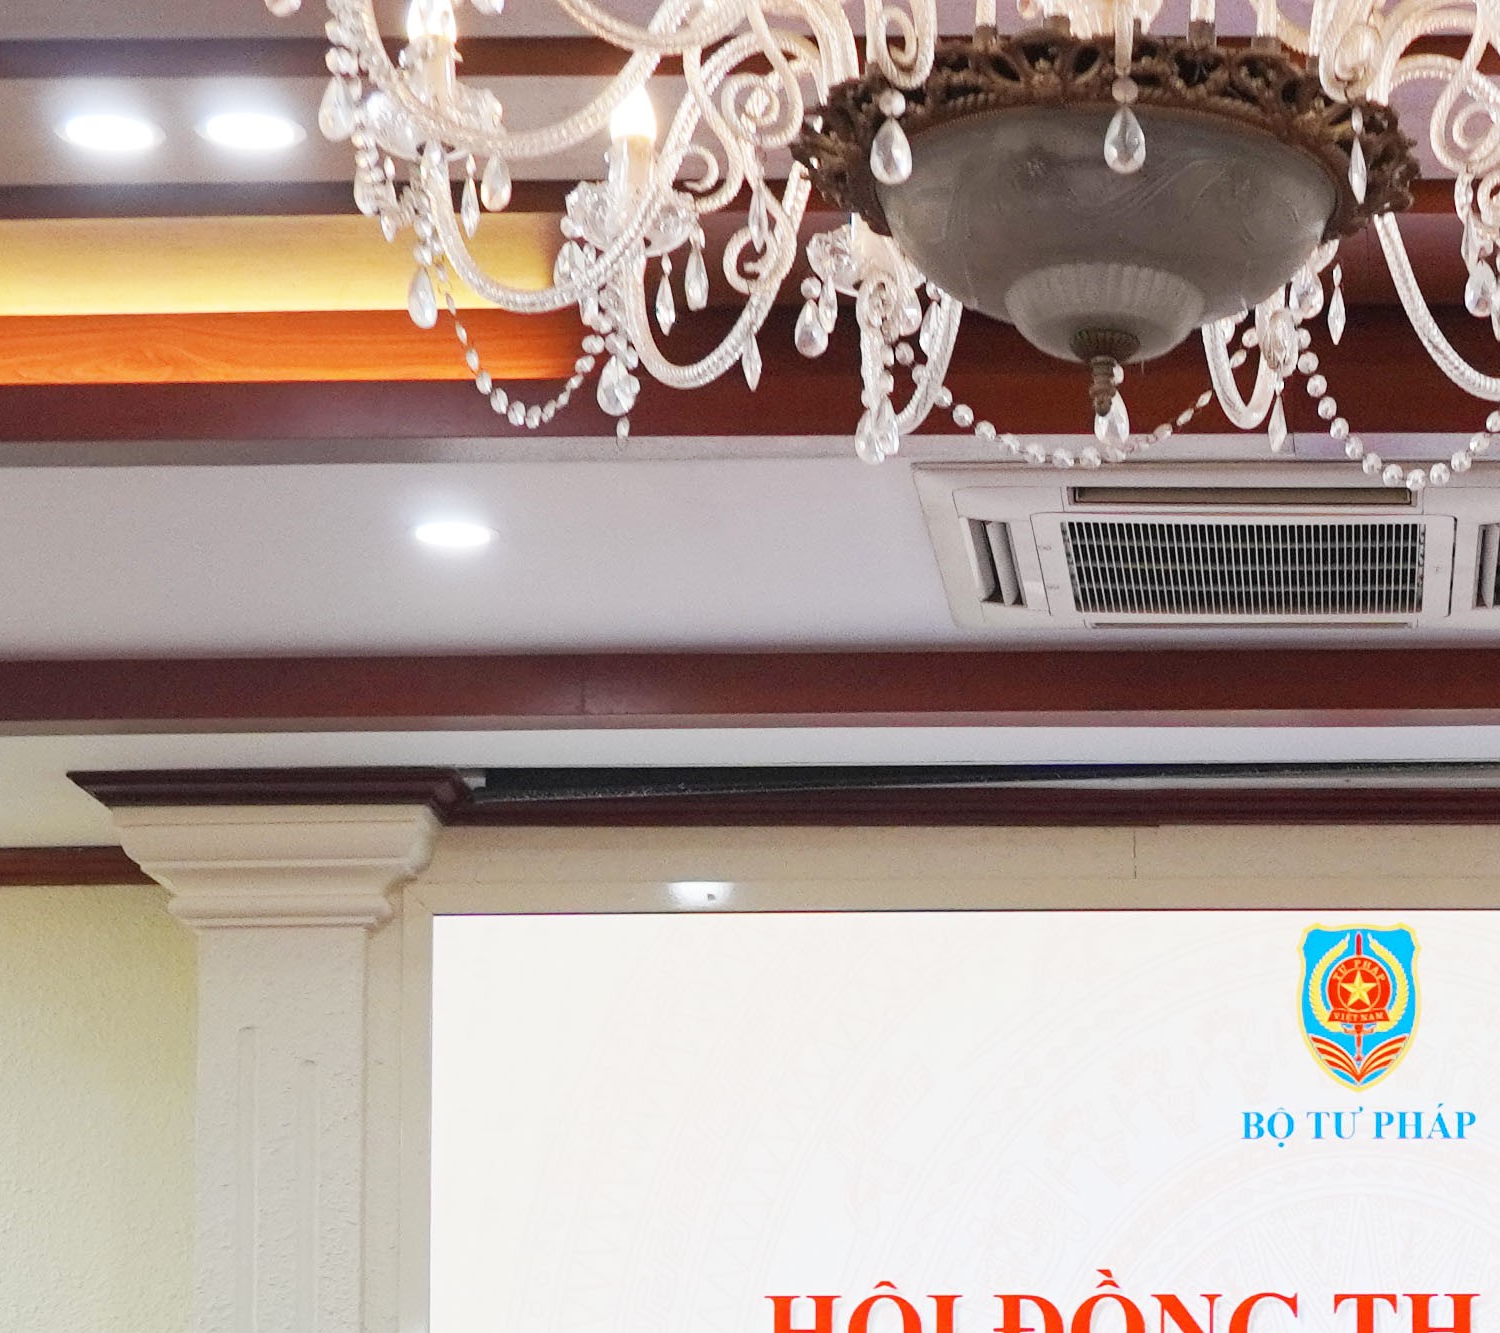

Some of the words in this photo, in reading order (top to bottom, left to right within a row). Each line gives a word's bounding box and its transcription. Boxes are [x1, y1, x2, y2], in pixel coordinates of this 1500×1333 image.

[1242, 1106, 1295, 1148] BỘ
[1306, 1105, 1364, 1140] TƯ
[1372, 1102, 1477, 1140] PHÁP
